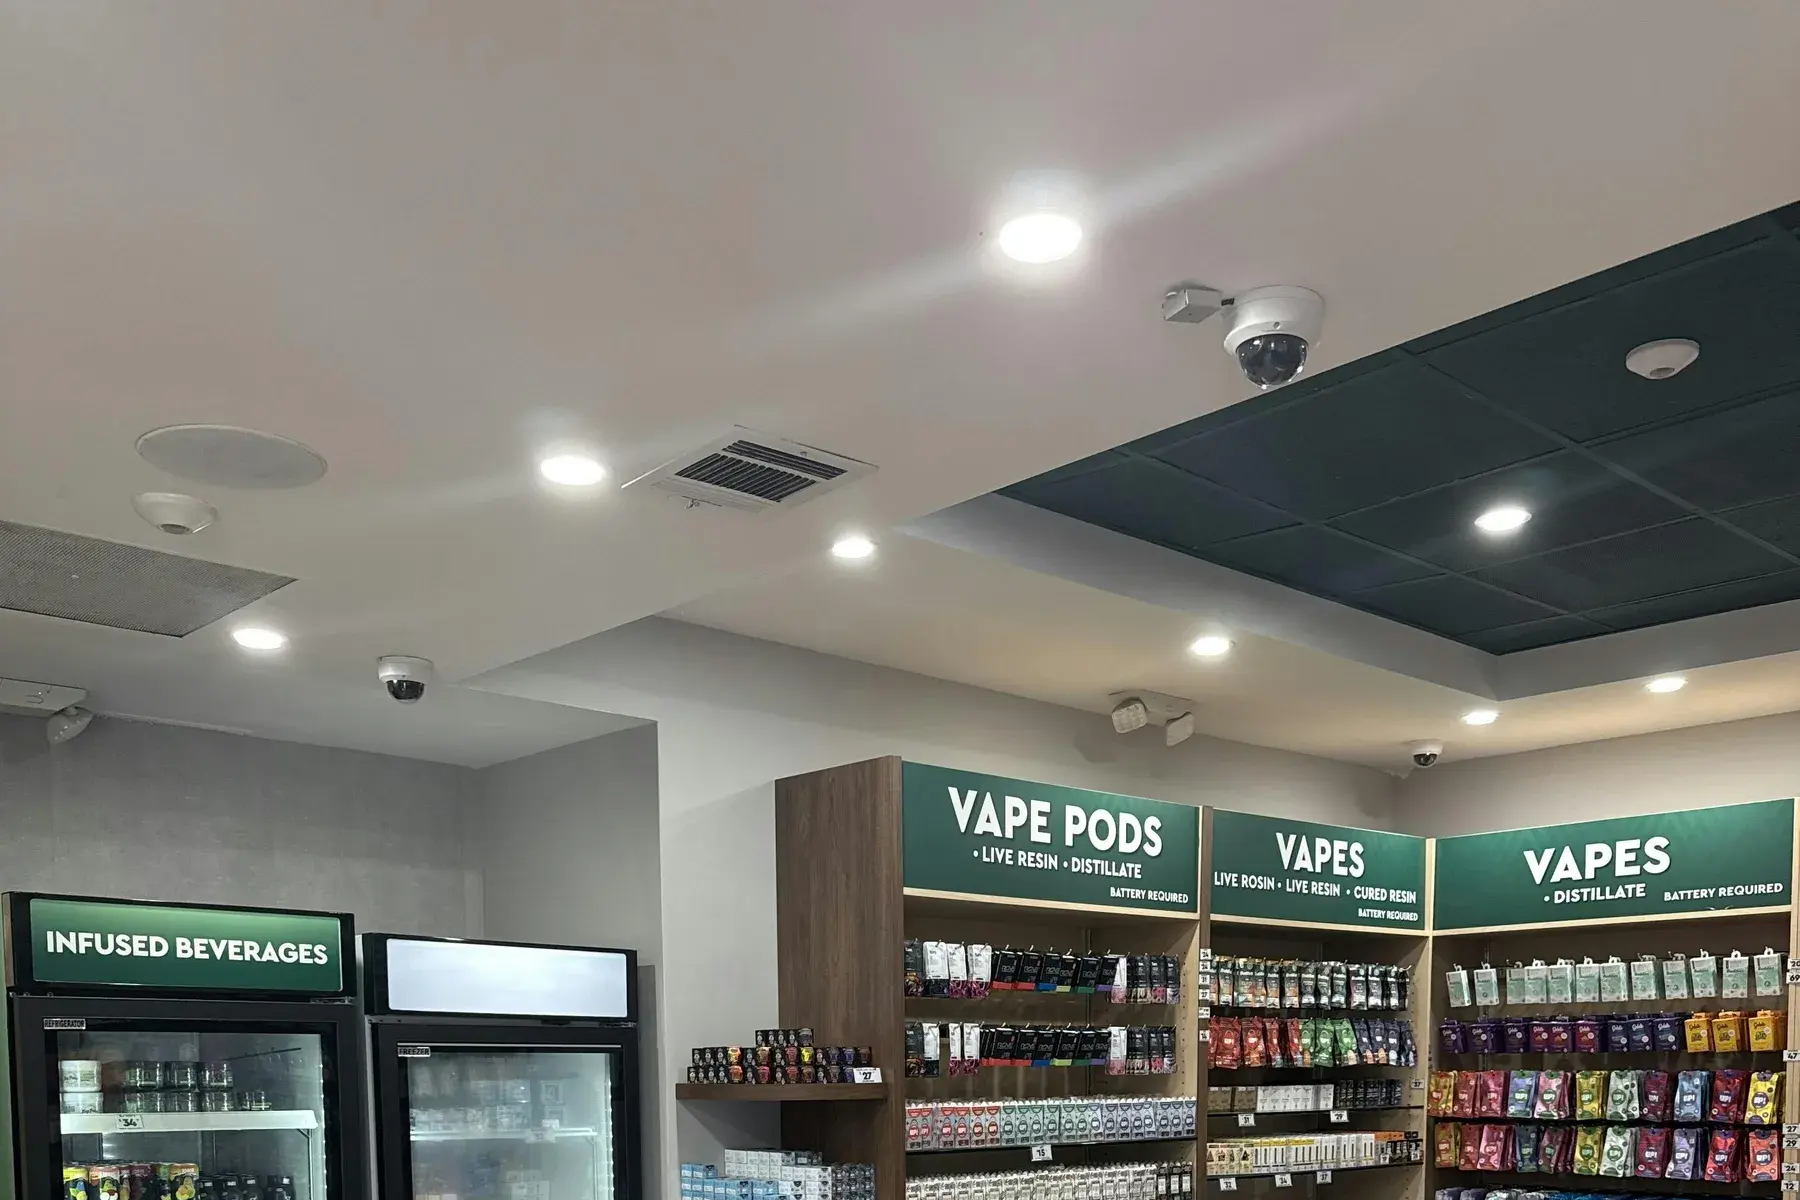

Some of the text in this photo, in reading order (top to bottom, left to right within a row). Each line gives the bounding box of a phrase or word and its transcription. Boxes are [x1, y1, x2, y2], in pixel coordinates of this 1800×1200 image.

[948, 786, 1163, 857] VAPE PODS
[982, 845, 1142, 879] LIVE RESIN DISTILLATE
[1275, 832, 1365, 878] VAPES
[1523, 835, 1671, 885] VAPES
[1110, 887, 1188, 904] BATTERY REQUIRED
[1214, 871, 1417, 904] LIVE ROSIN LIVE RESIN CURED RESIN
[1553, 882, 1646, 904] DISTILLATE
[1663, 883, 1783, 902] BATTERY REQUIRED
[1358, 908, 1418, 922] BATTERY REQUIRED
[46, 930, 329, 965] INFUSED BEVERAGES
[44, 1020, 86, 1028] REFRIGERATOR
[399, 1048, 430, 1056] FREEZER
